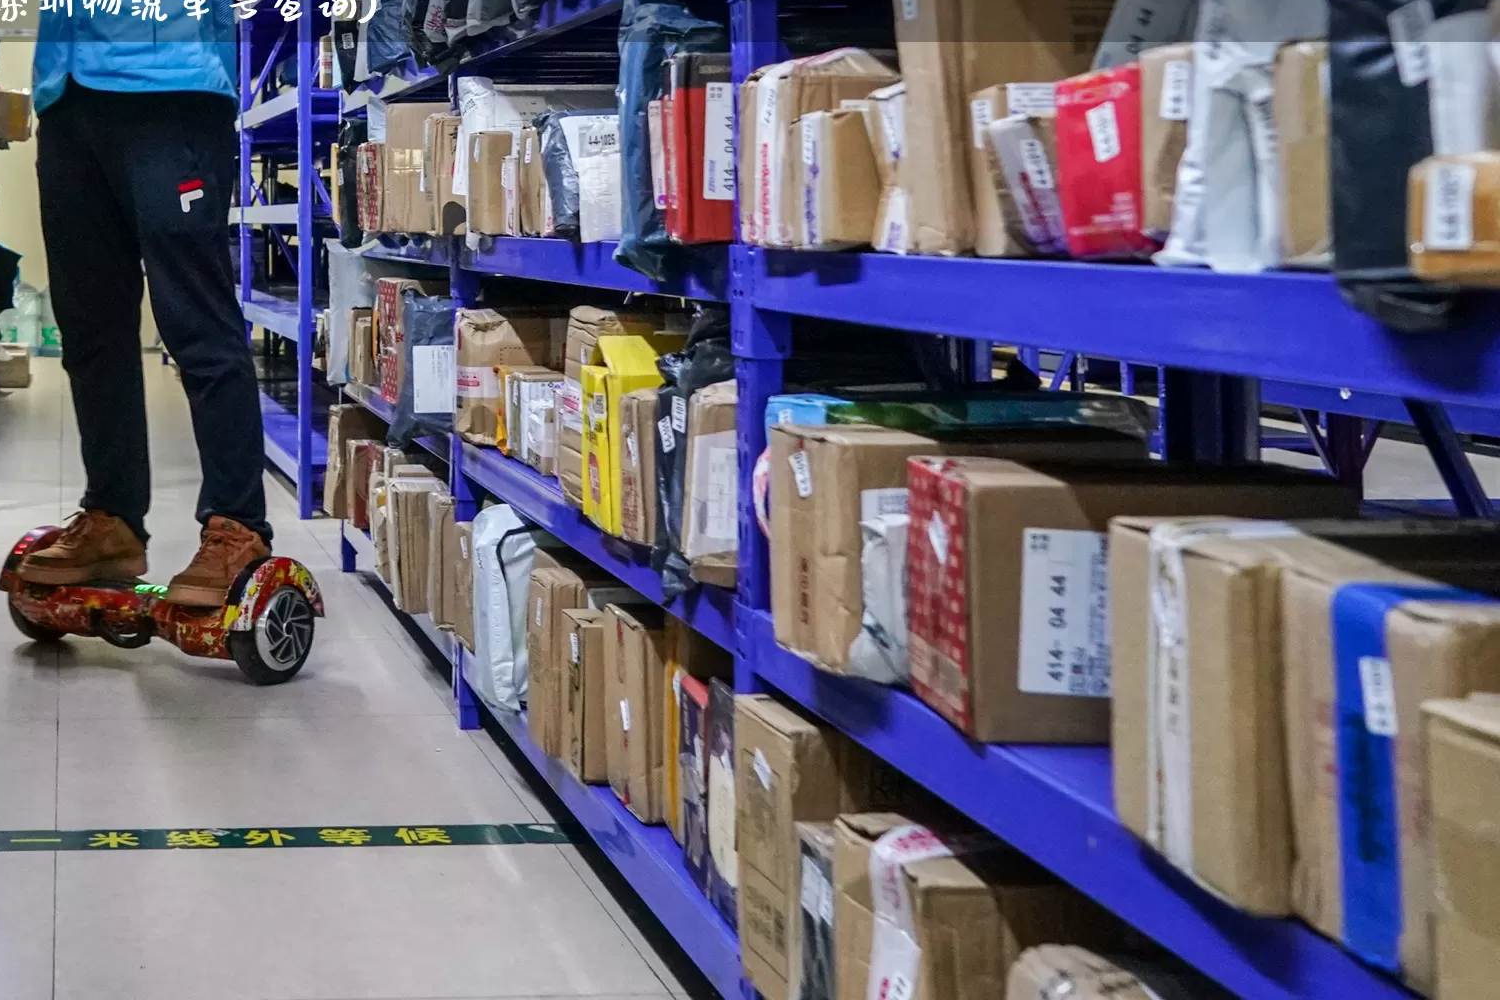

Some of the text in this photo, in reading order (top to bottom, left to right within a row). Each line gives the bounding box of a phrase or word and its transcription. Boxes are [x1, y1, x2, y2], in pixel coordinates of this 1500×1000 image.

[588, 133, 616, 146] 4-4-1025
[1046, 575, 1068, 682] 414- 04 44
